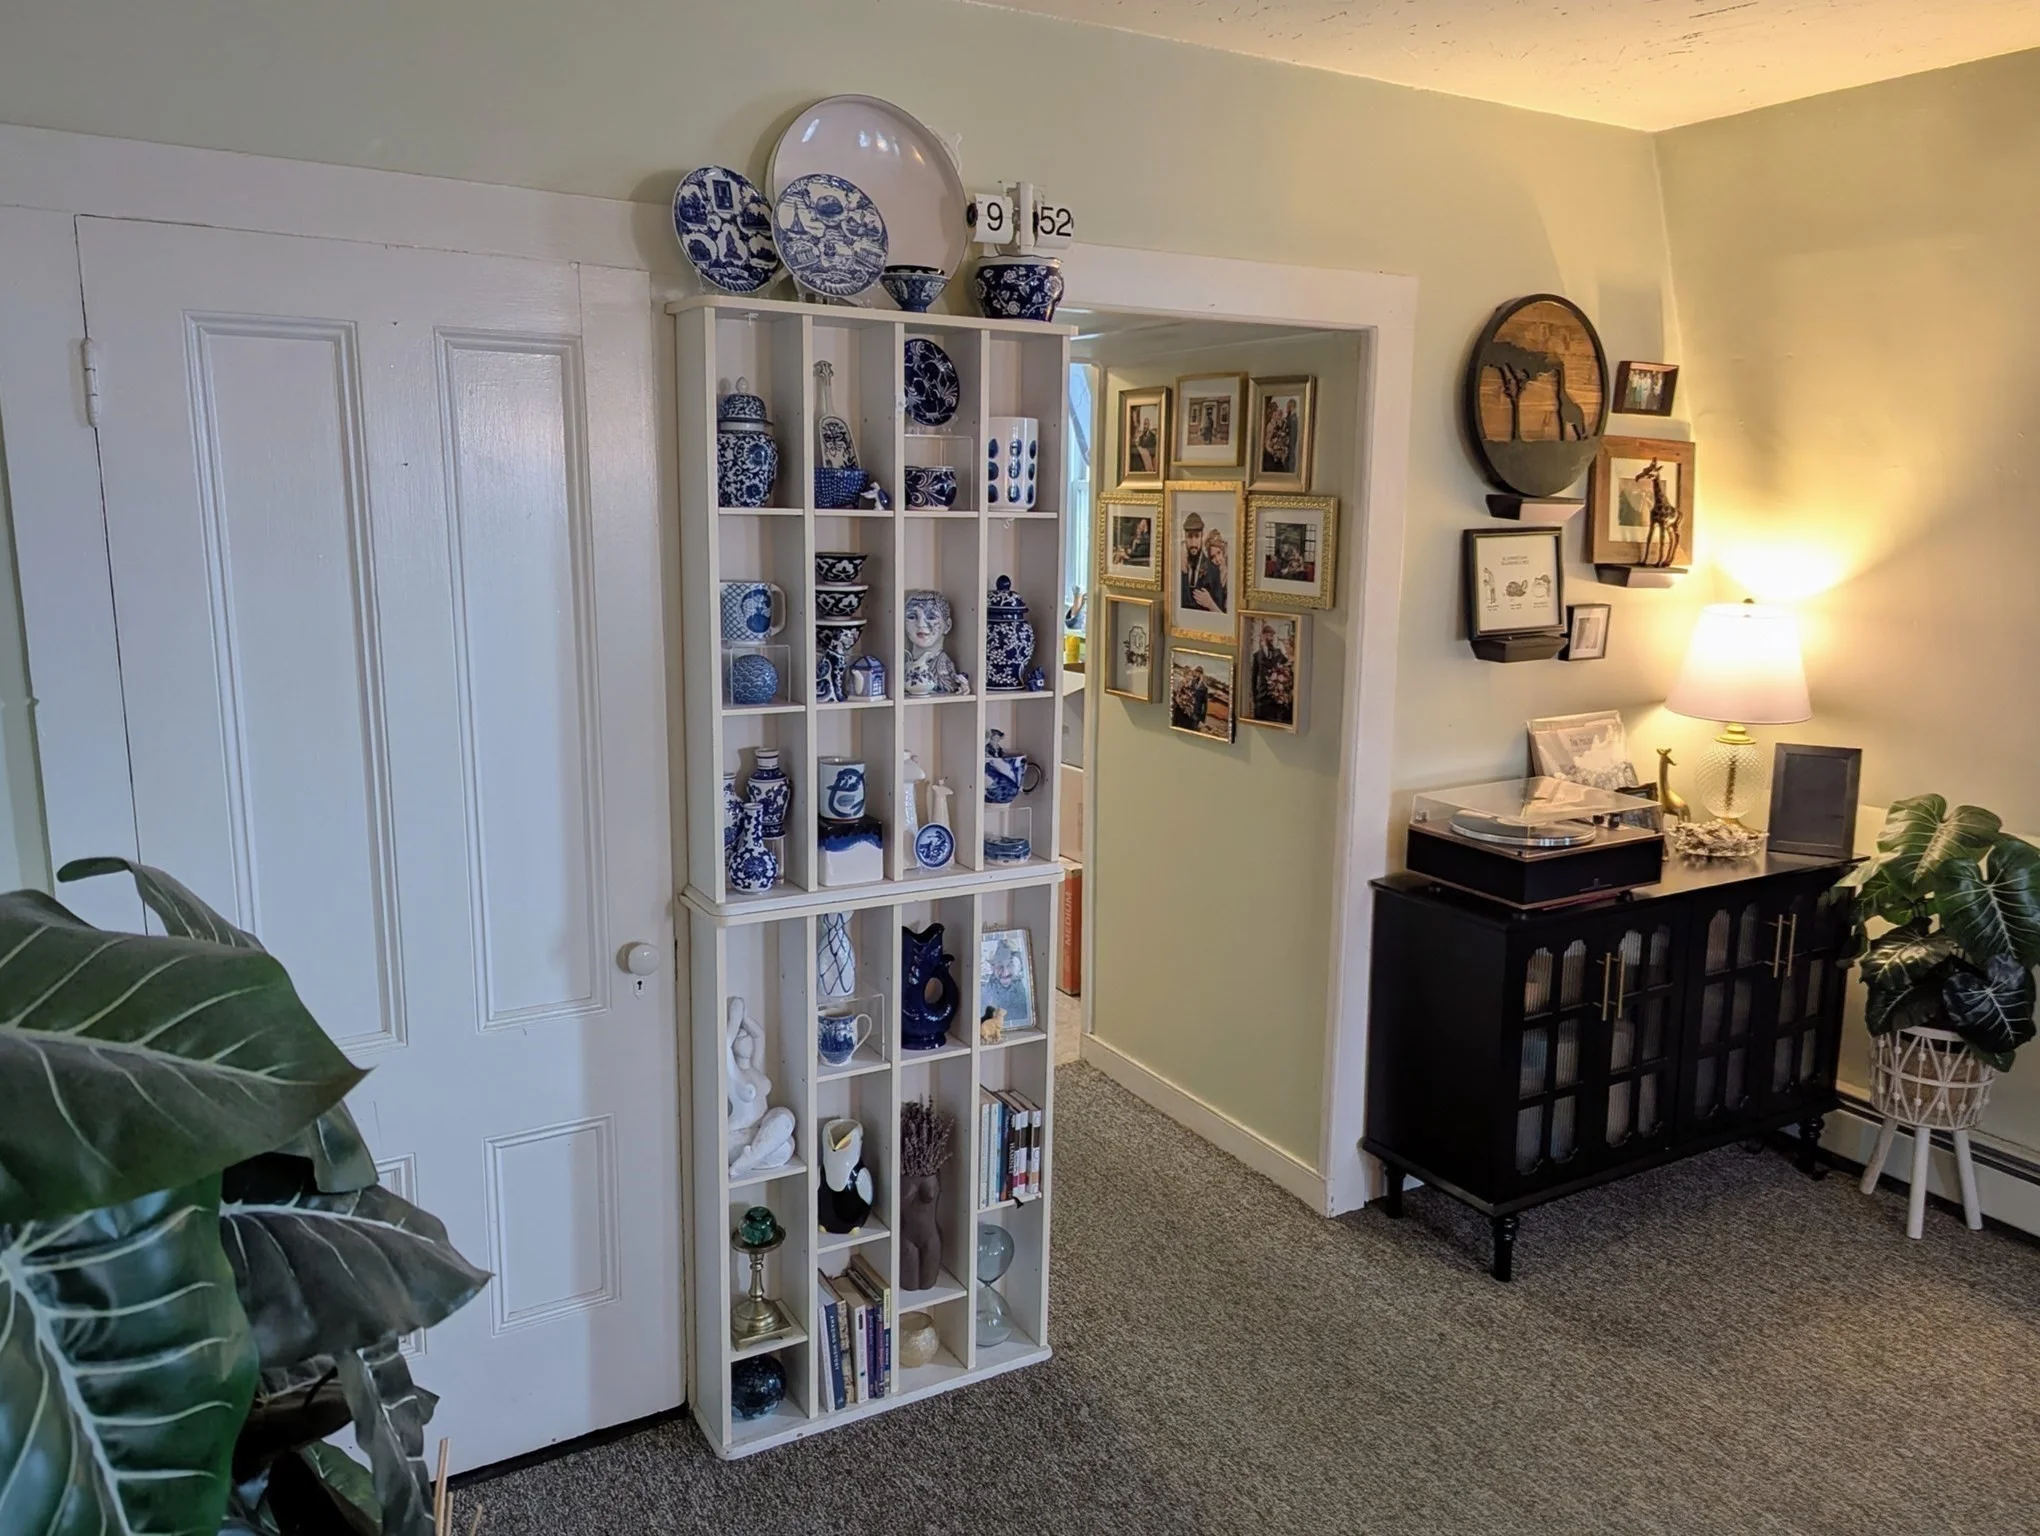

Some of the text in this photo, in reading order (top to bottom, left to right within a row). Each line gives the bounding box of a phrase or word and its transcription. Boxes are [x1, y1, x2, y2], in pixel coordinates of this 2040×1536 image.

[987, 202, 1003, 231] 9
[1040, 206, 1072, 237] 52
[1064, 891, 1073, 946] MEDIUM
[829, 1315, 837, 1344] AMAZING
